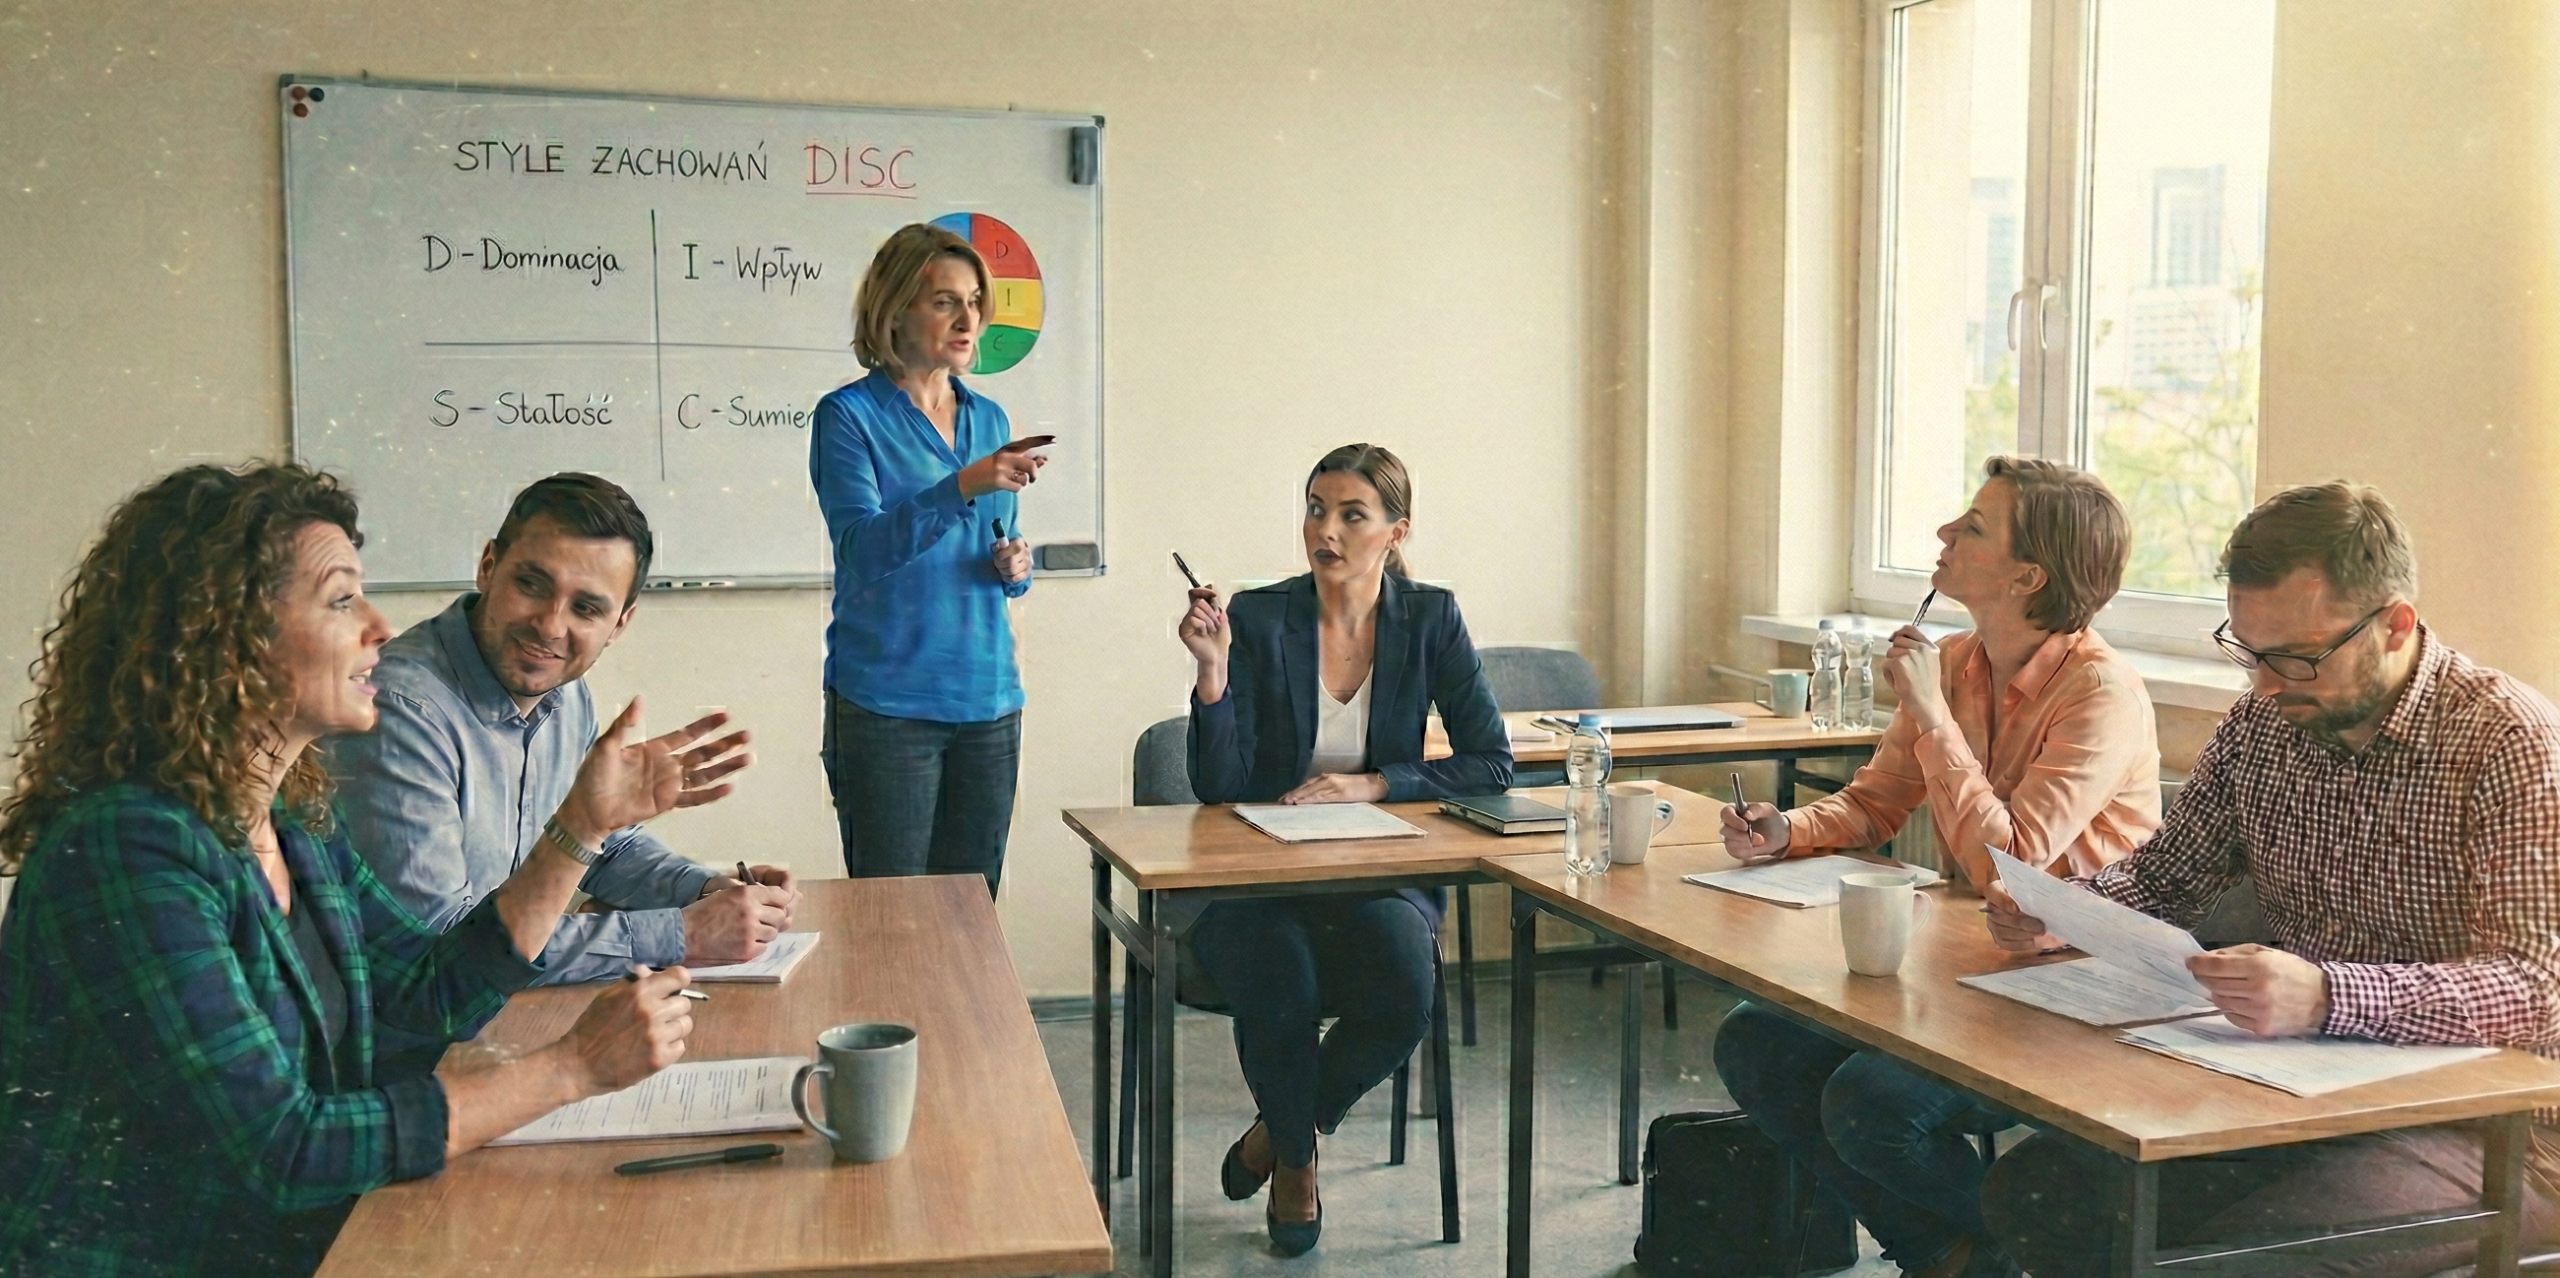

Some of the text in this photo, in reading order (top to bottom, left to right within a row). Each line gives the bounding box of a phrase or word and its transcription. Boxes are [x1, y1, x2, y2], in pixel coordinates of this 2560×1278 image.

[453, 140, 565, 173] STYLE
[803, 144, 917, 190] DISC
[995, 240, 1009, 259] D
